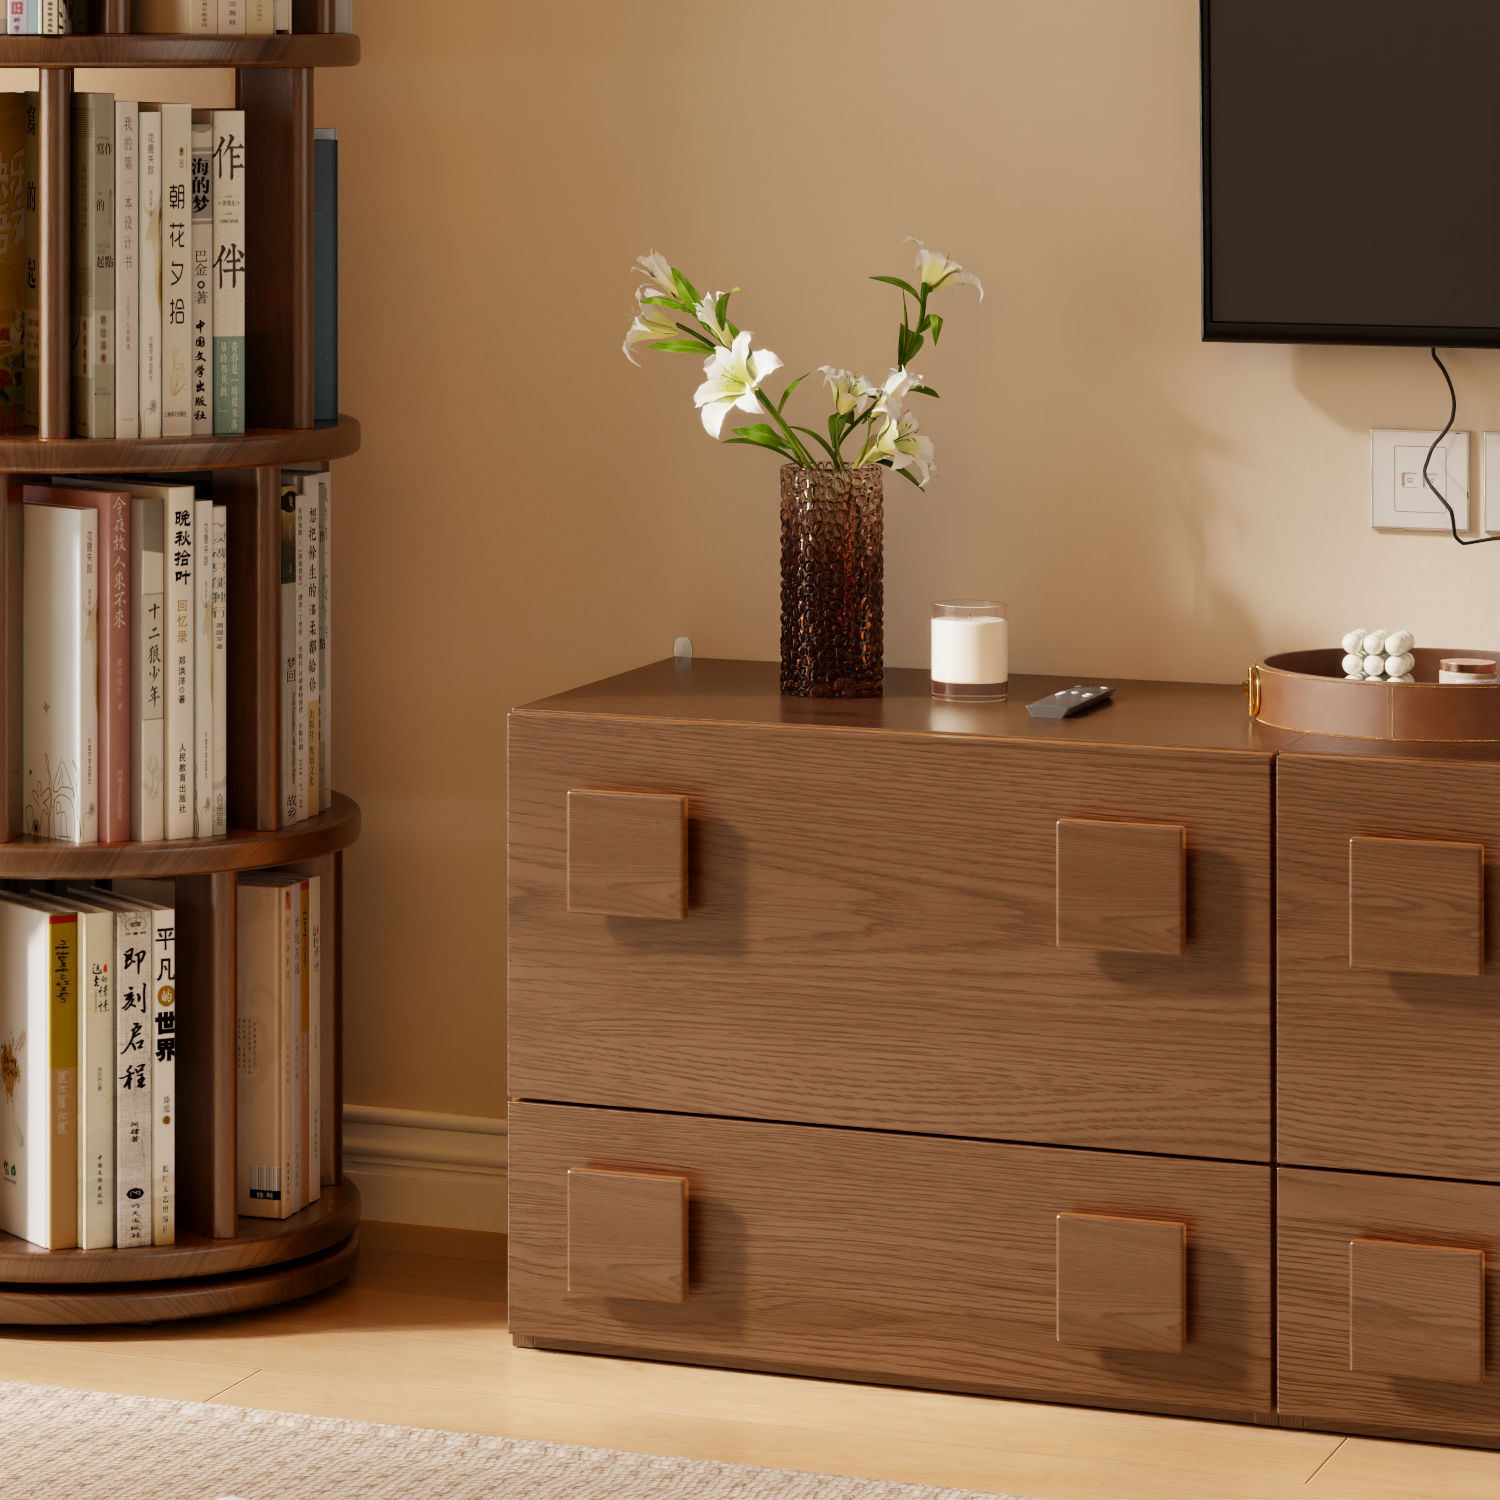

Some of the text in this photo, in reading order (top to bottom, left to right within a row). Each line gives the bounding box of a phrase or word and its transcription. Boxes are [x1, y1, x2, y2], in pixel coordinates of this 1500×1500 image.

[96, 142, 113, 155] 寫作
[27, 182, 36, 212] 的
[97, 198, 105, 212] 的
[124, 116, 133, 270] 我的第一本设计书
[191, 158, 210, 214] 海的梦
[27, 258, 36, 289] 起
[97, 256, 114, 268] 起點
[169, 184, 185, 325] 朝花夕拾
[195, 250, 208, 276] 巴金
[193, 319, 208, 422] 中国文学出版社
[112, 496, 127, 629] 今夜故人來不來
[174, 510, 191, 586] 晚秋拾叶
[176, 599, 188, 644] 回忆录
[286, 656, 297, 684] 梦回
[178, 742, 186, 814] 人民教育出版社
[286, 793, 297, 822] 故乡
[119, 947, 147, 1090] 即刻启程
[155, 928, 175, 1062] 平凡的世界
